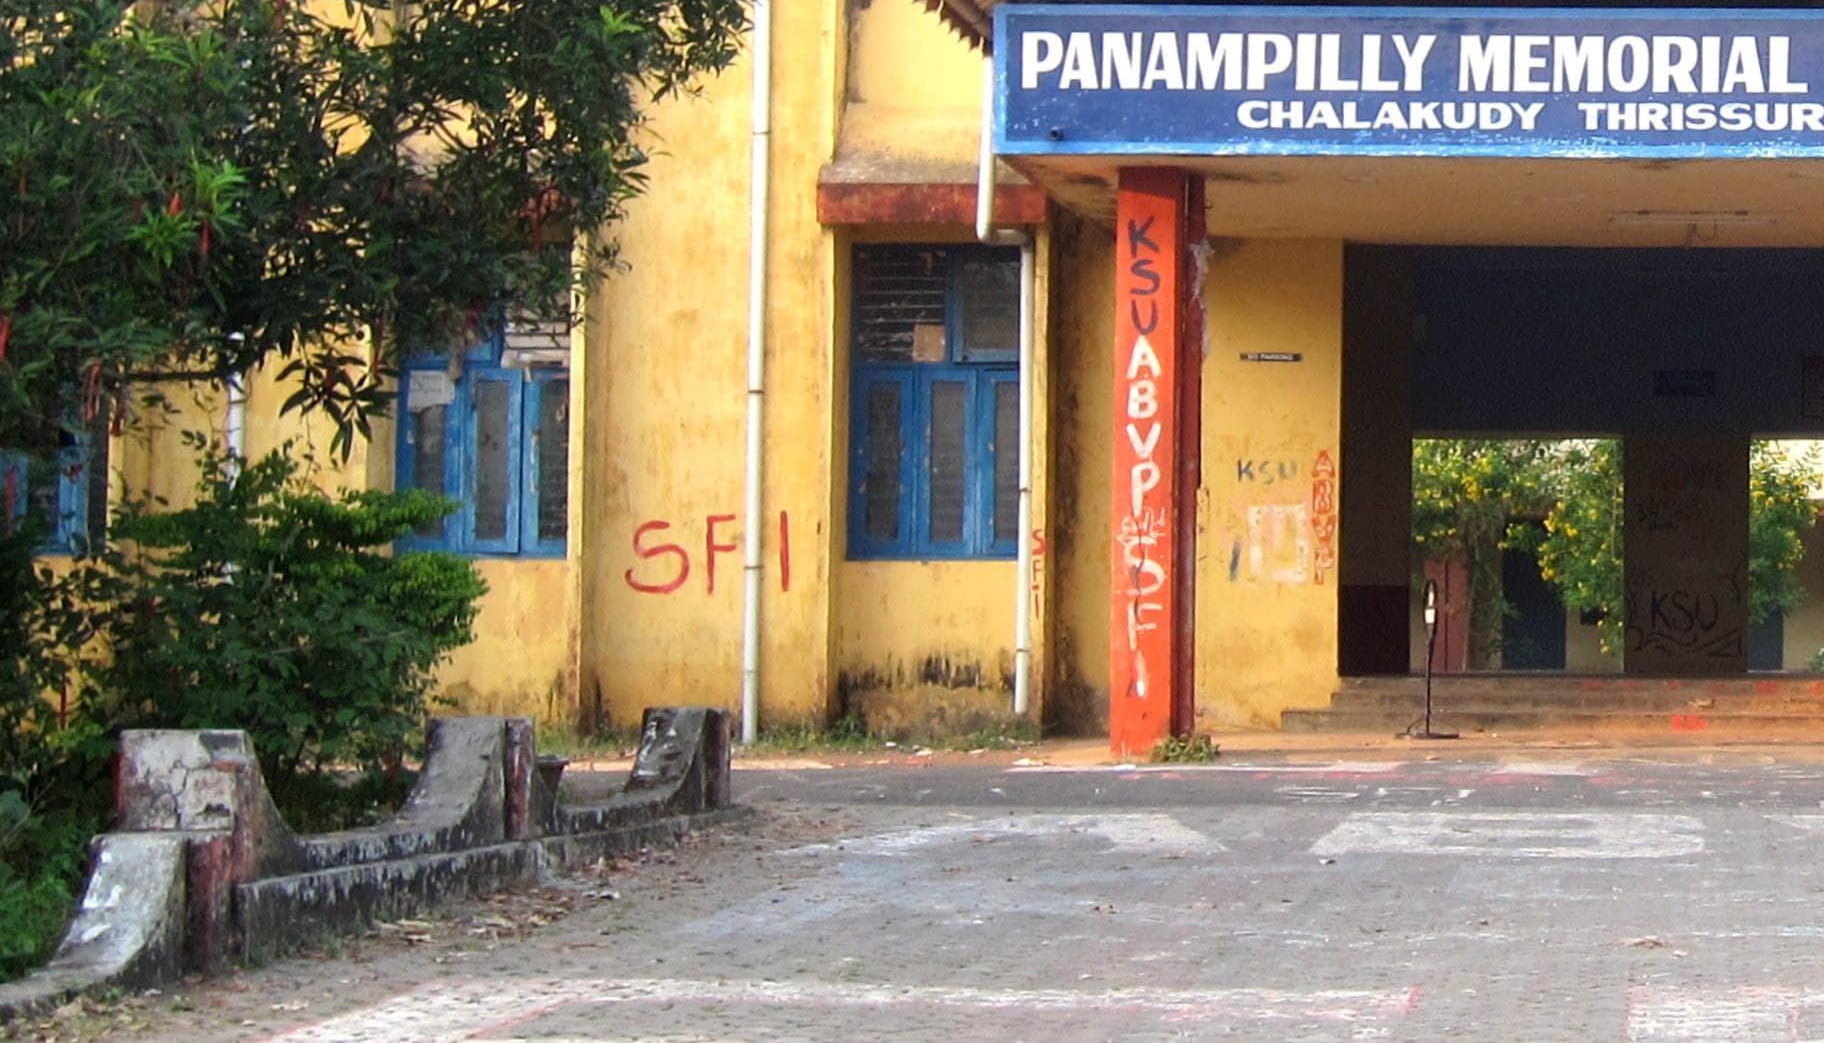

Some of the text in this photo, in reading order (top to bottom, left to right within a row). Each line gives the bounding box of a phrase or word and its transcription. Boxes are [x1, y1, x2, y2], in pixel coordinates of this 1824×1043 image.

[1020, 31, 1436, 92] PANAMPILLY
[1458, 34, 1807, 94] MEMORIAL
[1236, 99, 1545, 130] CHALAKUDY
[1127, 215, 1162, 336] KSU
[1126, 334, 1163, 518] ABVP
[1237, 458, 1299, 485] KSU
[1651, 590, 1719, 633] KSU
